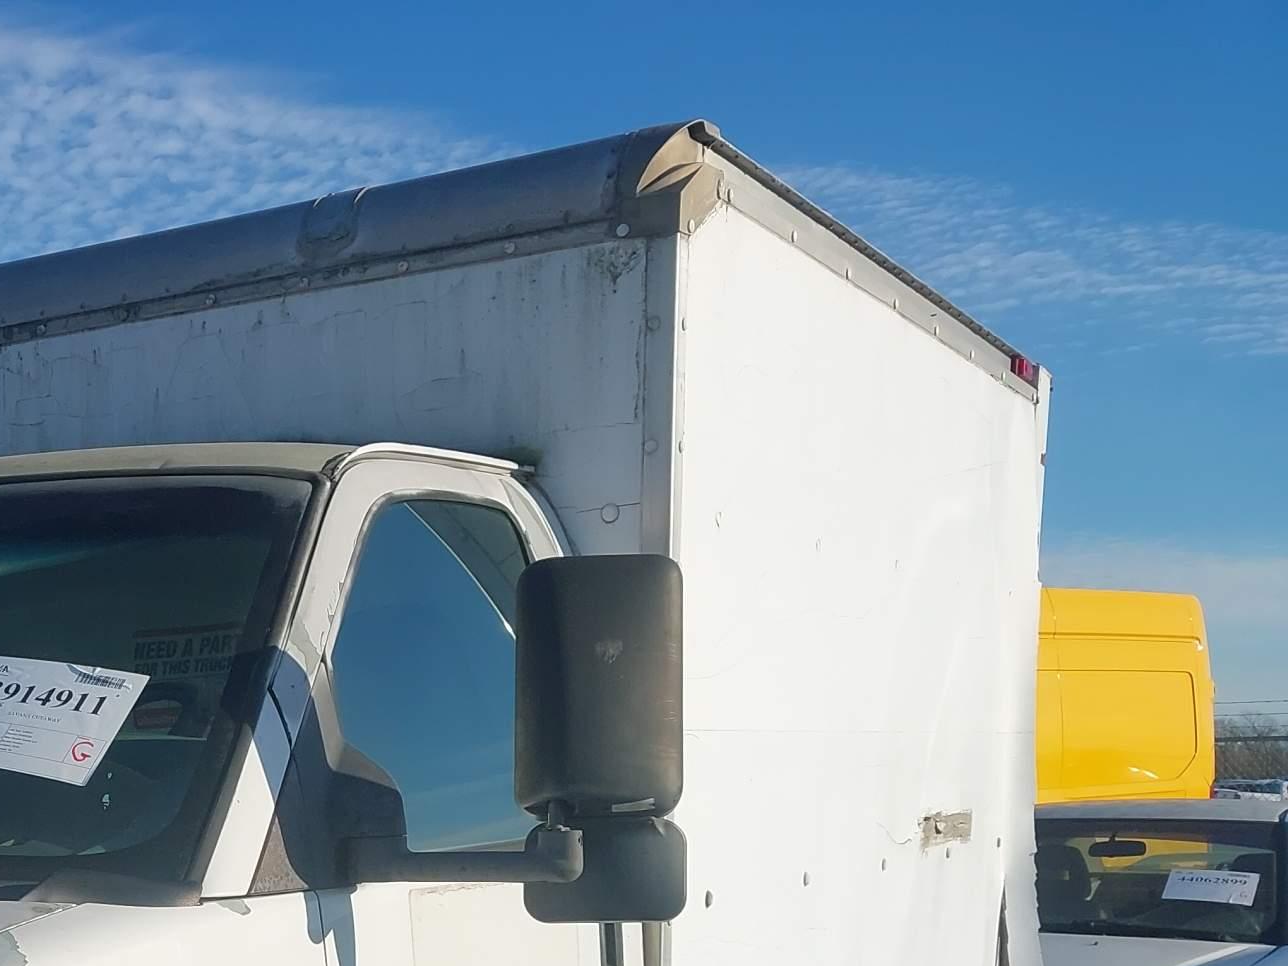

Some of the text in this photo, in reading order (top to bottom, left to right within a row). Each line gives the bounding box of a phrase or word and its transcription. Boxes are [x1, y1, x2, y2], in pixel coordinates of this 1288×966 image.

[134, 640, 178, 660] NEED
[181, 638, 192, 657] A
[162, 660, 190, 675] THIS
[71, 741, 95, 762] G
